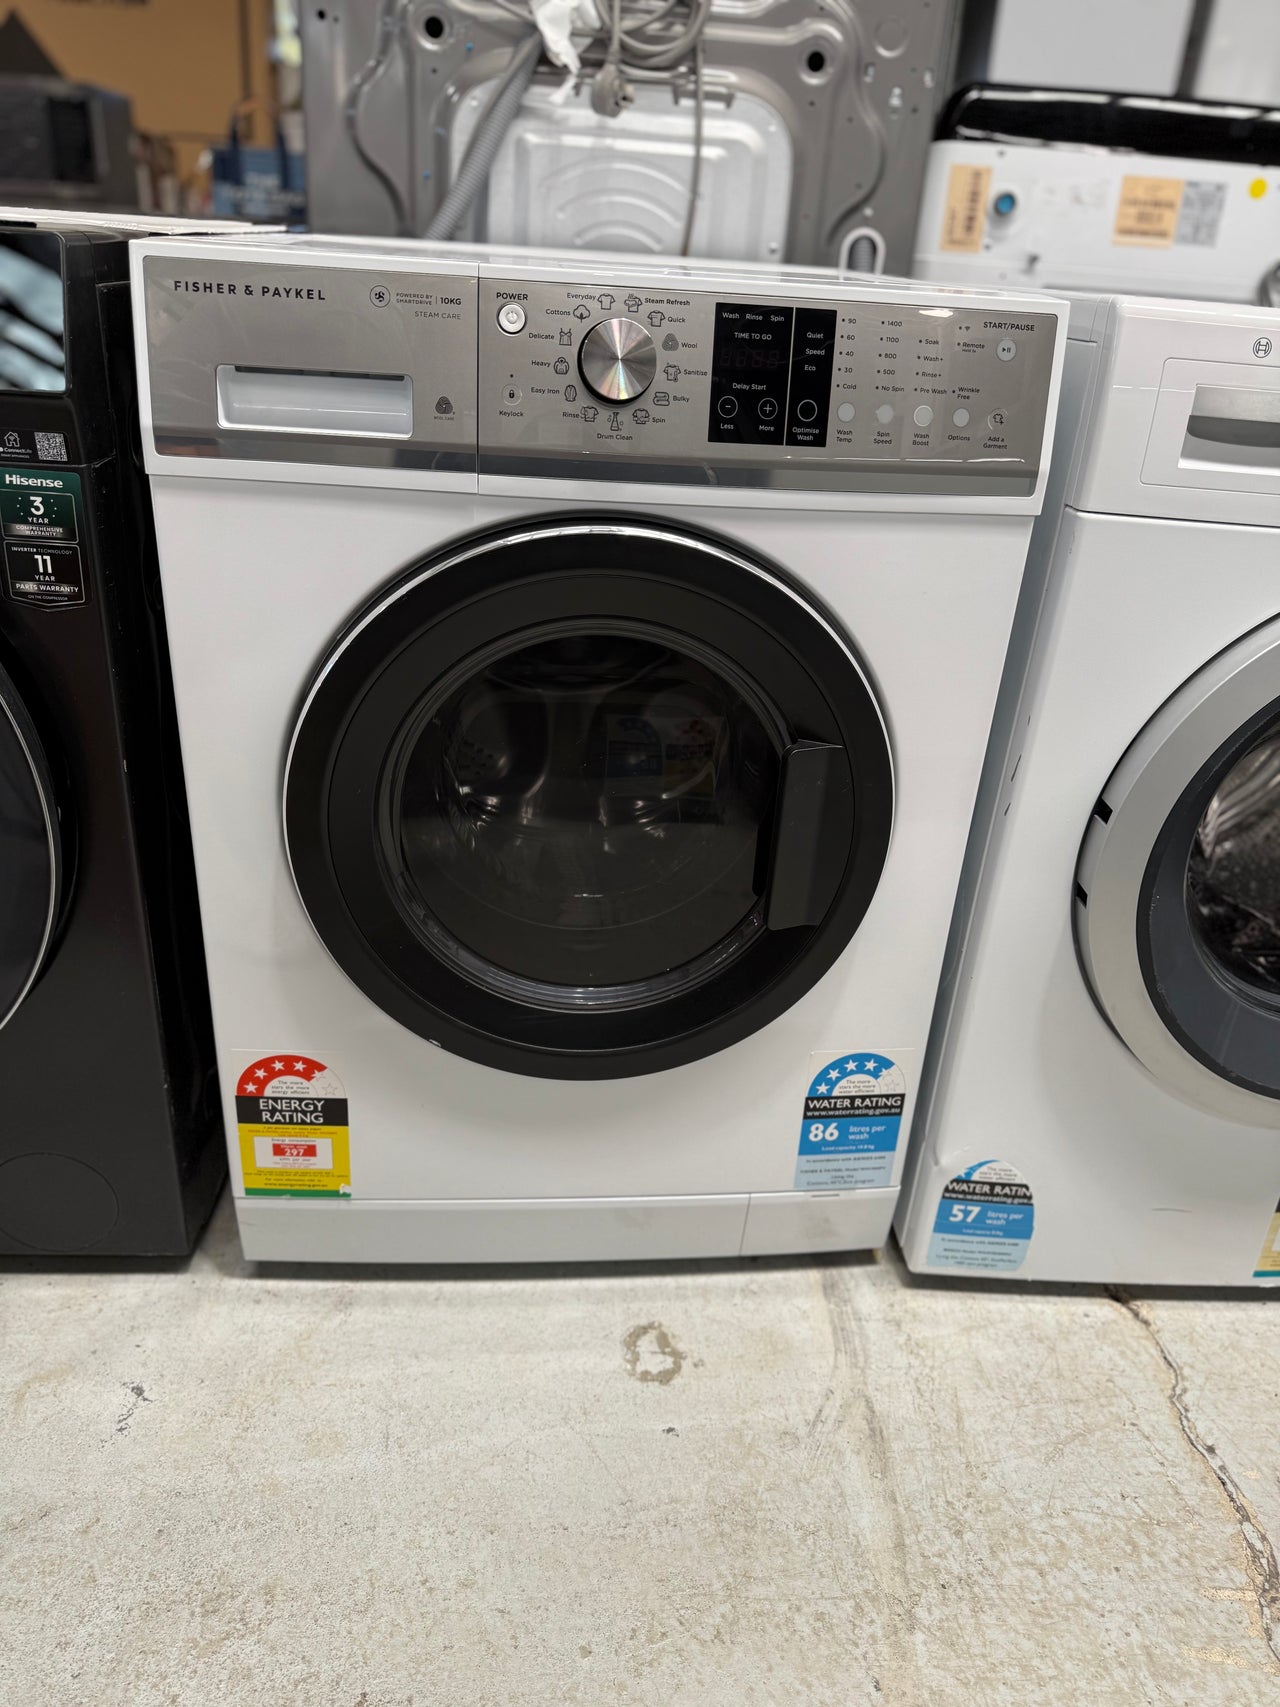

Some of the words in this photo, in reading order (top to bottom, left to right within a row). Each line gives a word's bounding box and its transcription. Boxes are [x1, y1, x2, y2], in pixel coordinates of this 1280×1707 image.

[174, 280, 237, 295] FISHER
[244, 285, 254, 296] &
[261, 286, 326, 300] PAYKEL
[496, 292, 528, 301] POWER
[567, 292, 596, 300] Everyday
[396, 298, 432, 306] SMARTDRIVE
[440, 296, 462, 305] 10KG
[644, 297, 665, 305] Steam
[666, 298, 690, 306] Refresh
[414, 311, 440, 319] STEAM
[546, 308, 571, 316] Cottons
[667, 316, 686, 324] Quick
[746, 313, 763, 321] Rinse
[983, 321, 1035, 332] START/PAUSE
[529, 332, 555, 341] Delicate
[805, 348, 825, 356] Speed
[531, 359, 551, 368] Heavy
[683, 369, 708, 377] Sanitise
[883, 368, 896, 376] 500
[921, 371, 942, 379] Rinse+
[732, 382, 750, 390] Delay
[891, 385, 905, 393] Spin
[957, 386, 980, 394] Wrinkle
[531, 387, 546, 395] Easy
[547, 387, 560, 395] Iron
[672, 395, 690, 403] Bulky
[499, 410, 524, 418] Keylock
[562, 411, 580, 419] Rinse
[652, 416, 666, 424] Spin
[792, 426, 819, 435] Optimise
[836, 436, 852, 444] Temp
[5, 474, 63, 488] Hisense
[30, 496, 44, 516] 3
[16, 525, 63, 533] COMPREHENSIVE
[34, 554, 52, 574] 11
[35, 574, 55, 582] YEAR
[16, 583, 38, 591] PARTS
[39, 584, 79, 593] WARRANTY
[259, 1098, 325, 1111] ENERGY
[808, 1098, 850, 1109] WATER
[855, 1096, 901, 1107] RATING
[806, 1107, 900, 1116] www.waterrating.gov.au
[261, 1111, 324, 1123] RATING
[808, 1122, 839, 1142] 86
[849, 1125, 870, 1133] litres
[284, 1148, 304, 1156] 297
[946, 1182, 991, 1194] WATER
[994, 1185, 1032, 1197] RATIN
[949, 1204, 981, 1223] 57
[986, 1211, 1008, 1219] litres
